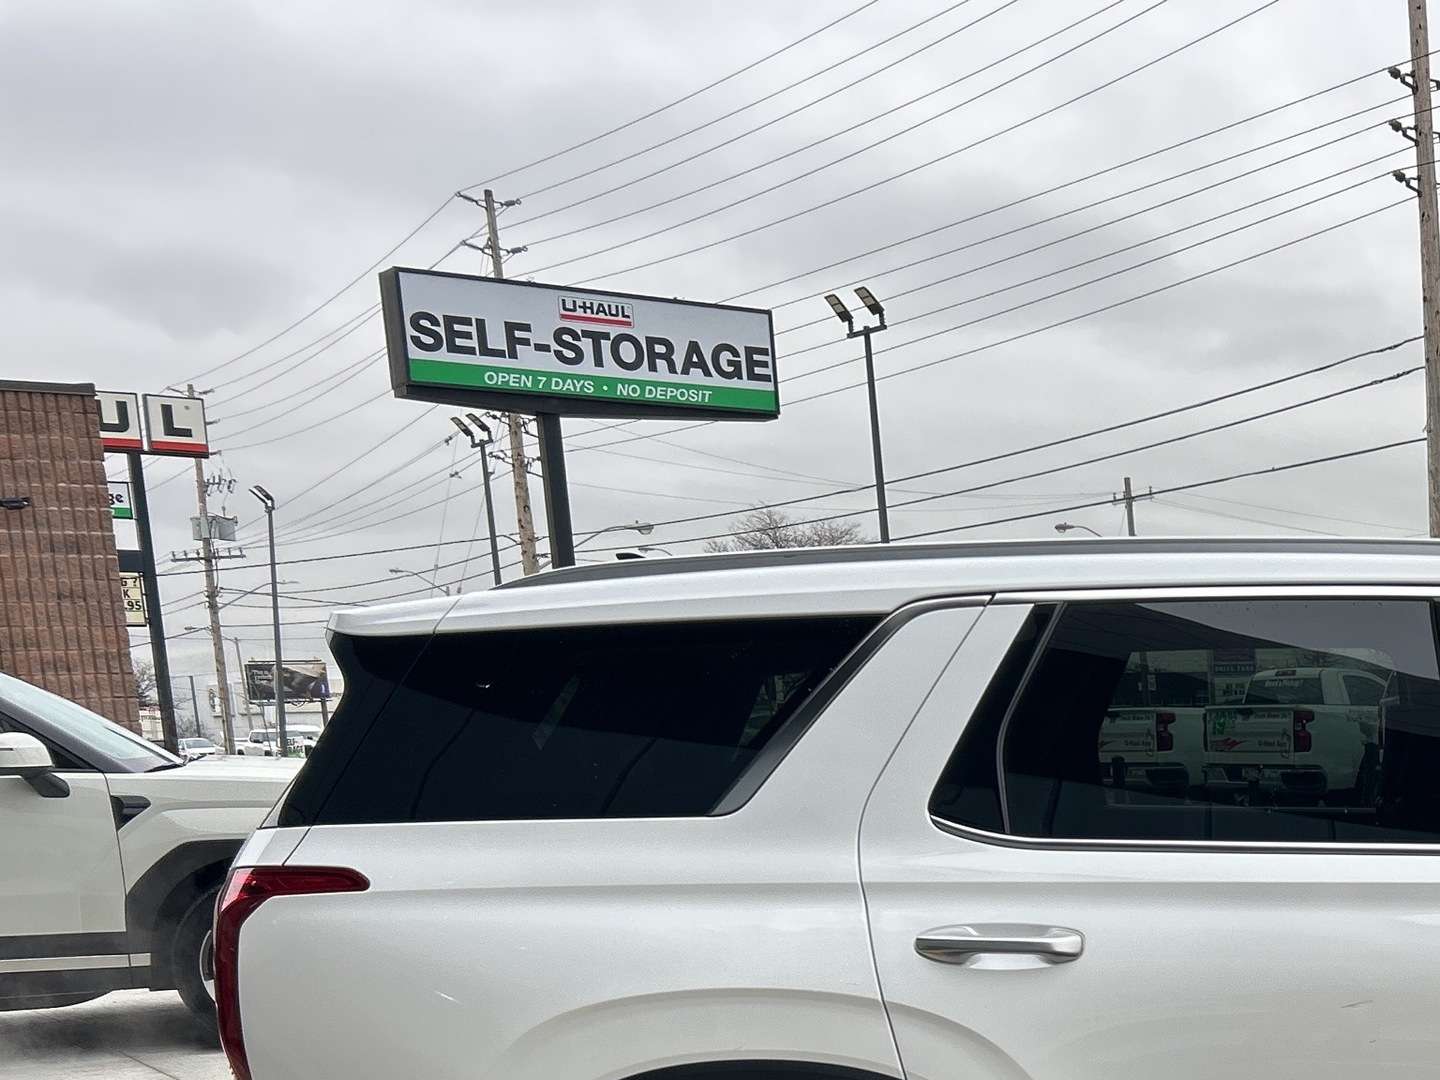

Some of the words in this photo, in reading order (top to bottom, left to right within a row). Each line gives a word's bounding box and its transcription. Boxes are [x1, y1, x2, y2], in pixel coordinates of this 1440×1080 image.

[561, 298, 631, 319] U-HAUL
[409, 311, 772, 383] SELF-STORAGE
[484, 371, 533, 388] OPEN
[537, 376, 547, 389] 7
[551, 378, 595, 393] DAYS
[616, 383, 641, 397] NO
[645, 385, 713, 402] DEPOSIT
